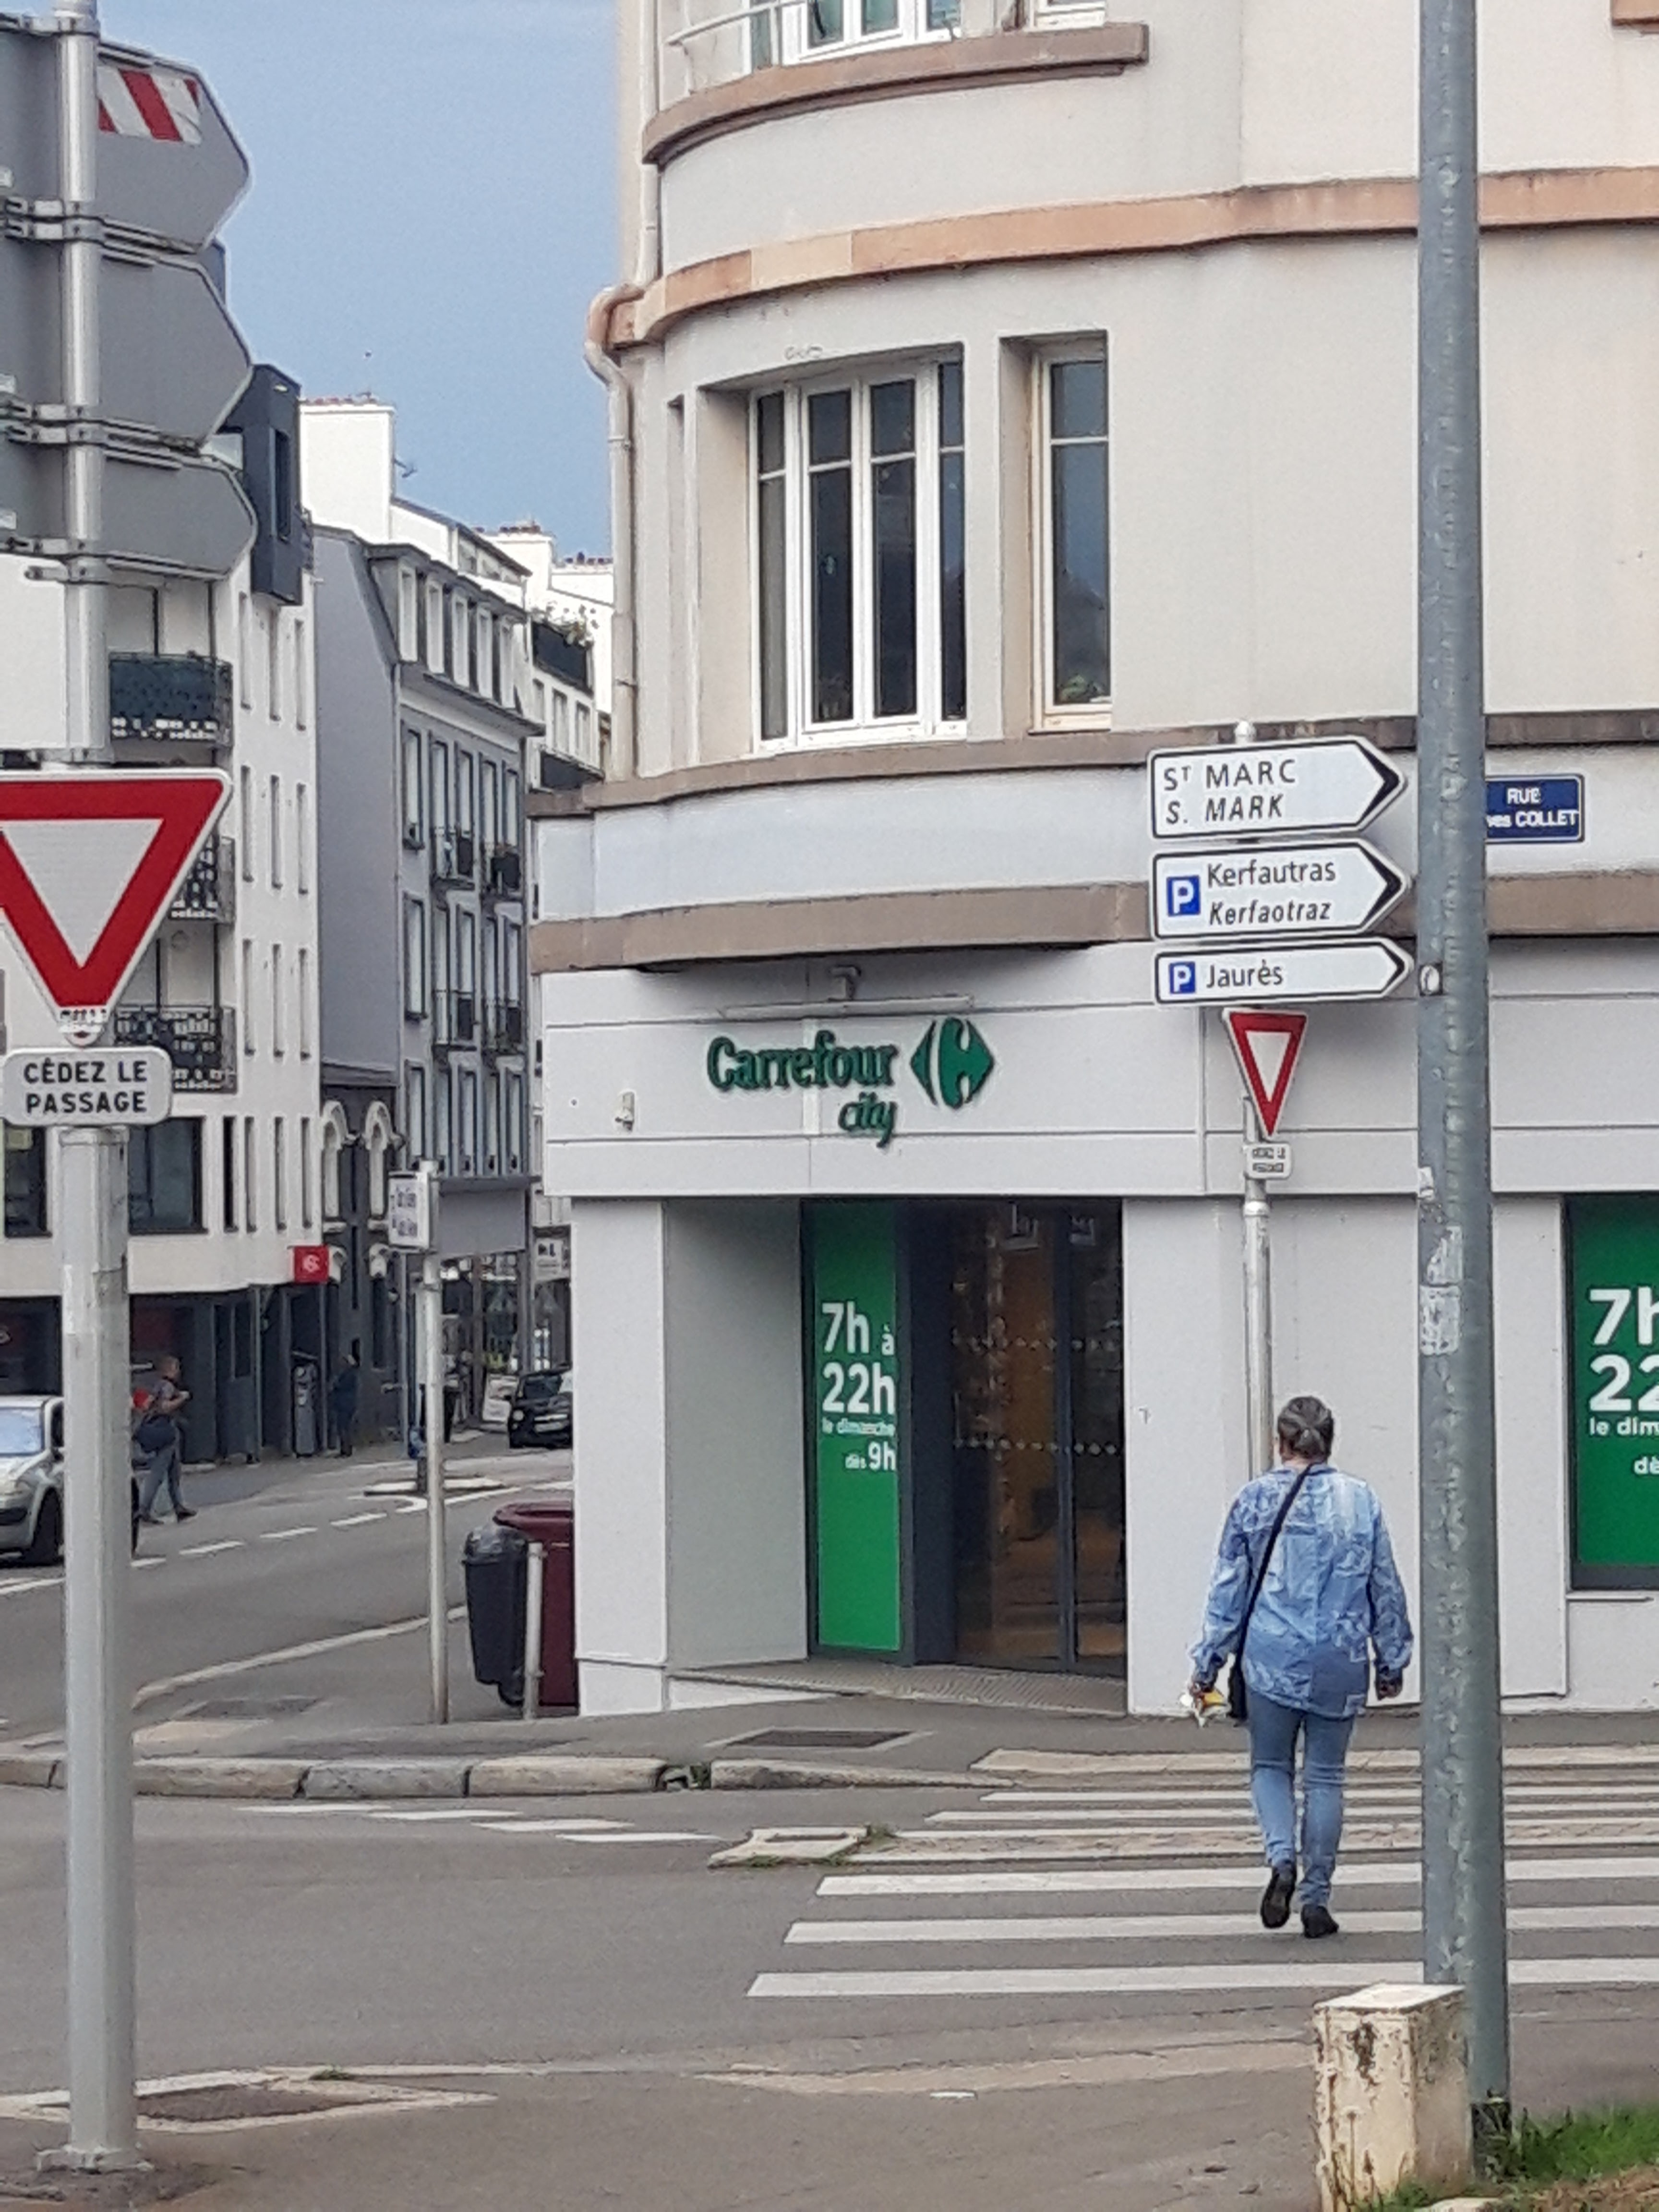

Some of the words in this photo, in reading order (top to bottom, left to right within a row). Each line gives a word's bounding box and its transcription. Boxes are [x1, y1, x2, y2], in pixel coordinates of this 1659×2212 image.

[1206, 759, 1296, 789] MARC
[1166, 801, 1188, 824] S.
[1205, 794, 1284, 821] MARK
[1507, 787, 1541, 805] RUE
[1515, 809, 1579, 828] COLLET
[1173, 880, 1194, 914] P
[1207, 860, 1336, 888] Kerfautras
[1209, 901, 1331, 926] Kerfaotraz
[1173, 965, 1192, 992] P
[1206, 960, 1284, 989] Jaurès
[24, 1057, 107, 1083] CÉDEZ
[118, 1061, 147, 1082] LE
[707, 1030, 899, 1092] Carrefour
[26, 1091, 147, 1114] PASSAGE
[838, 1091, 897, 1147] city
[822, 1301, 869, 1354] 7h
[822, 1362, 895, 1414] 22h
[1590, 1416, 1610, 1436] le
[868, 1441, 896, 1472] 9h
